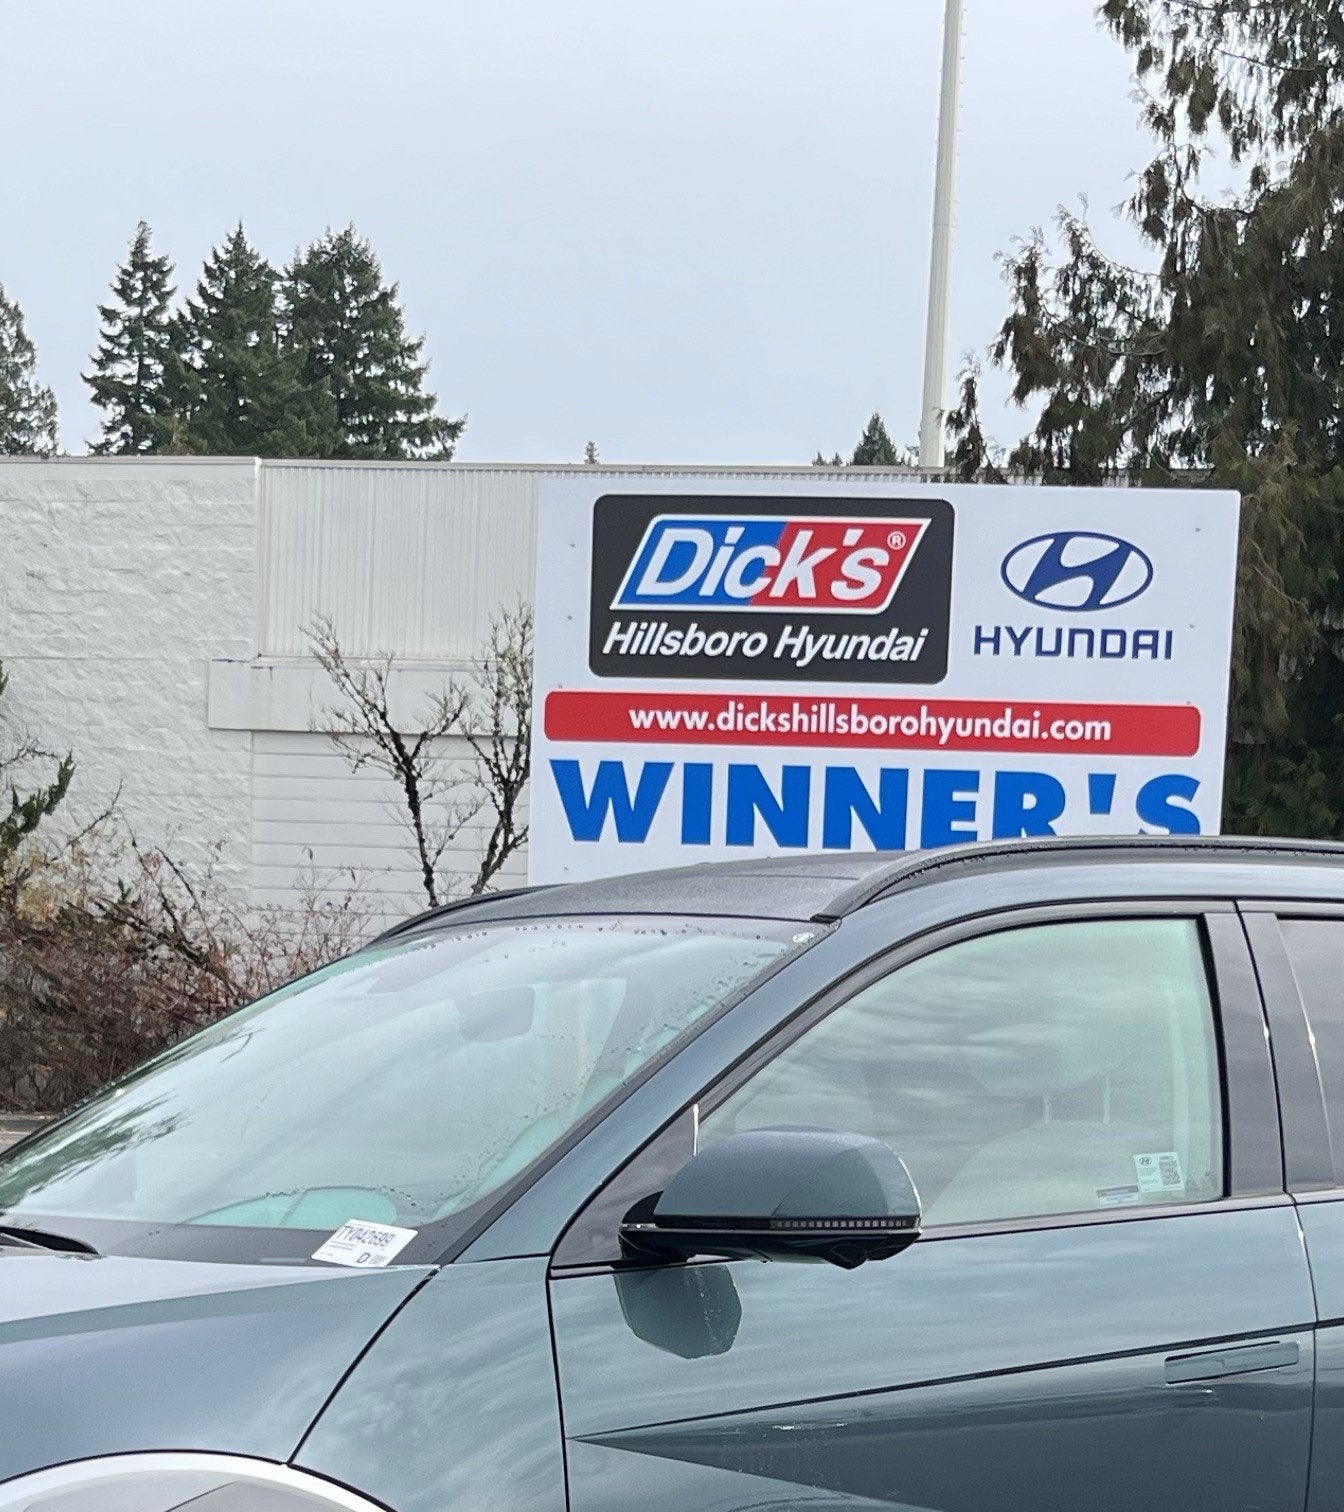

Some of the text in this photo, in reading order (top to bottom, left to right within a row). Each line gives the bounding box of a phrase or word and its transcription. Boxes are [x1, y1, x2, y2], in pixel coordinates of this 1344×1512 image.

[635, 526, 890, 601] Dick's
[602, 621, 929, 667] Hillsboro Hyundai
[973, 625, 1173, 660] HYUNDAI
[629, 700, 1112, 744] www.dickshillsborohyundai.com
[549, 759, 1201, 850] WINNER'S
